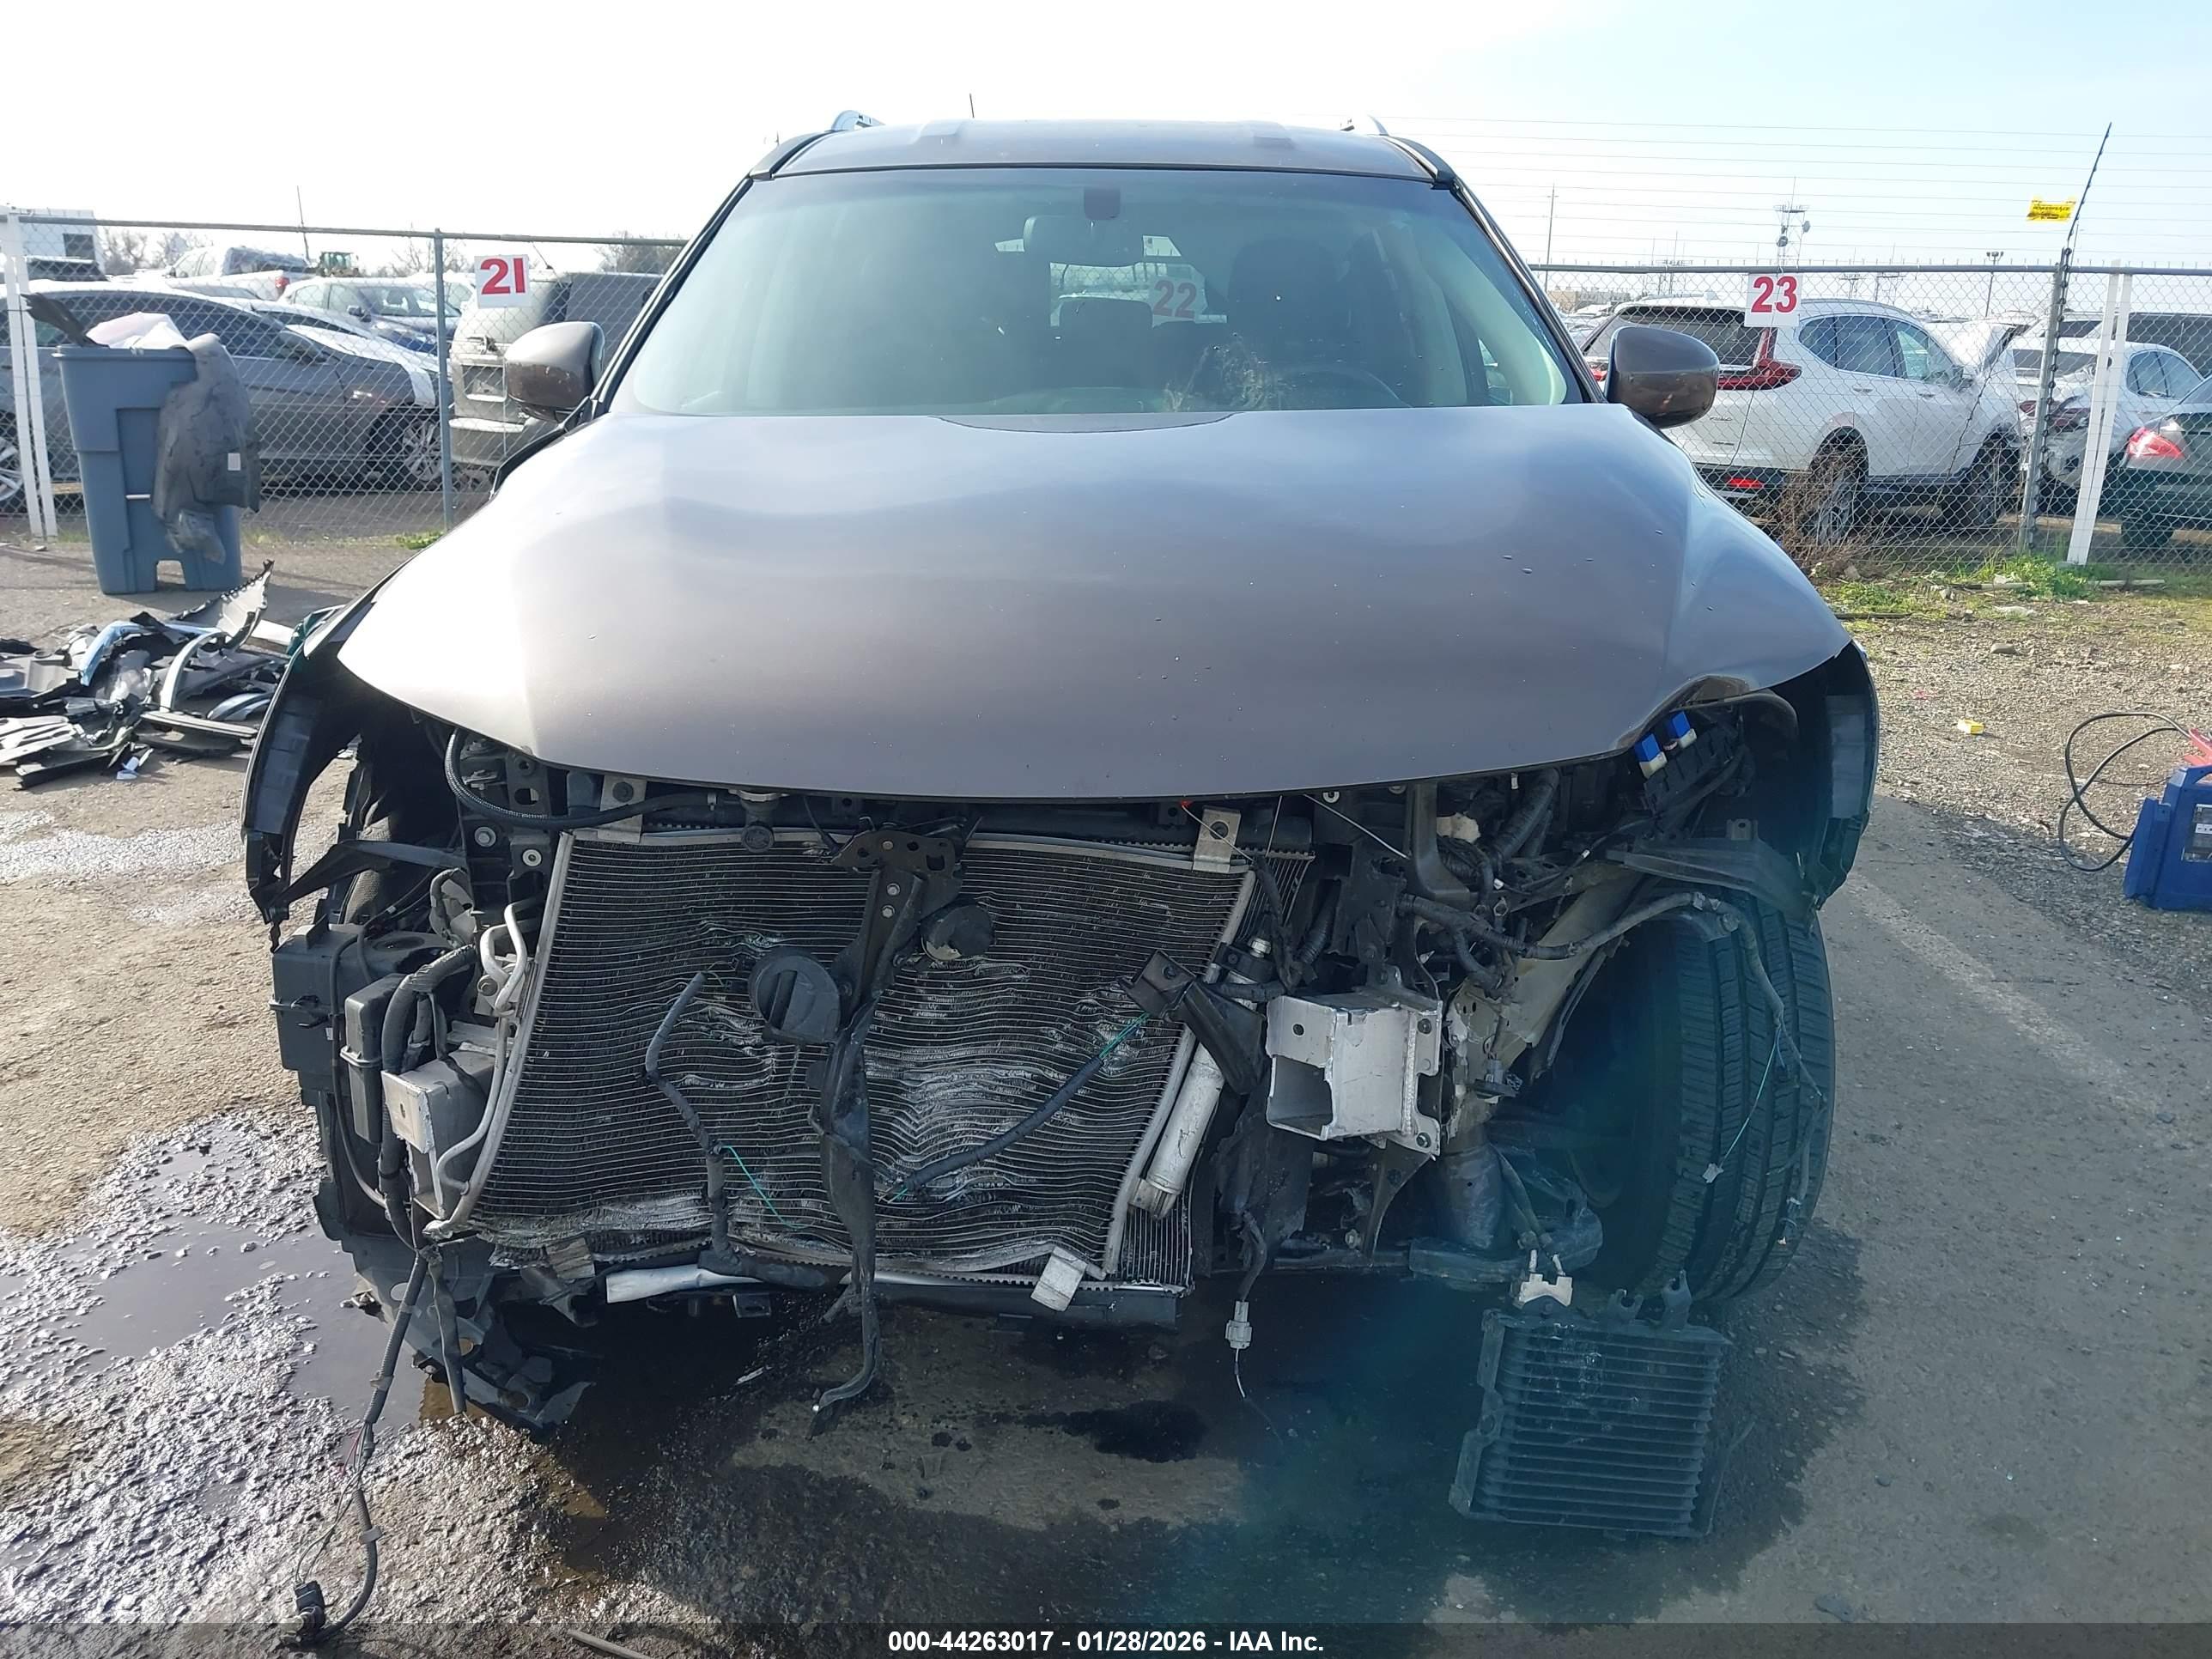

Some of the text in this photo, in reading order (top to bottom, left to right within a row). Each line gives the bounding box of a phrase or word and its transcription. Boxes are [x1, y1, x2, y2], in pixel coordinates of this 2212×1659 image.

[480, 258, 526, 295] 21
[1751, 276, 1797, 313] 23
[1153, 280, 1197, 319] 22
